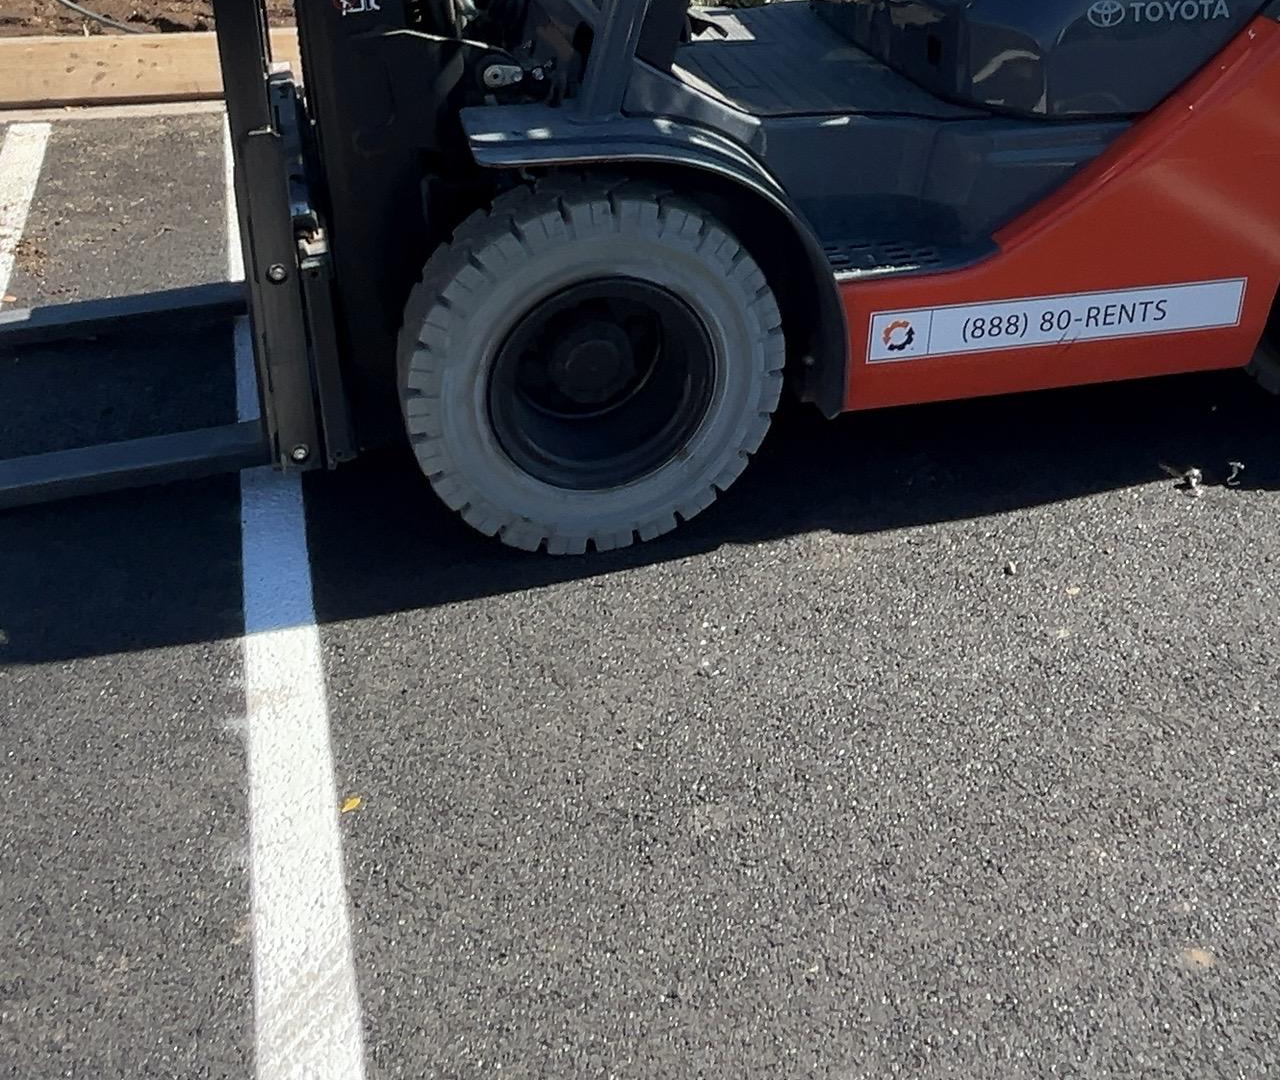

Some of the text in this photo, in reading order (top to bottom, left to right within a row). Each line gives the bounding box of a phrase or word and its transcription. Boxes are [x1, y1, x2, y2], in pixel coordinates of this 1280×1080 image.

[1130, 0, 1230, 22] TOYOTA
[961, 299, 1169, 343] (888) 80-RENTS
